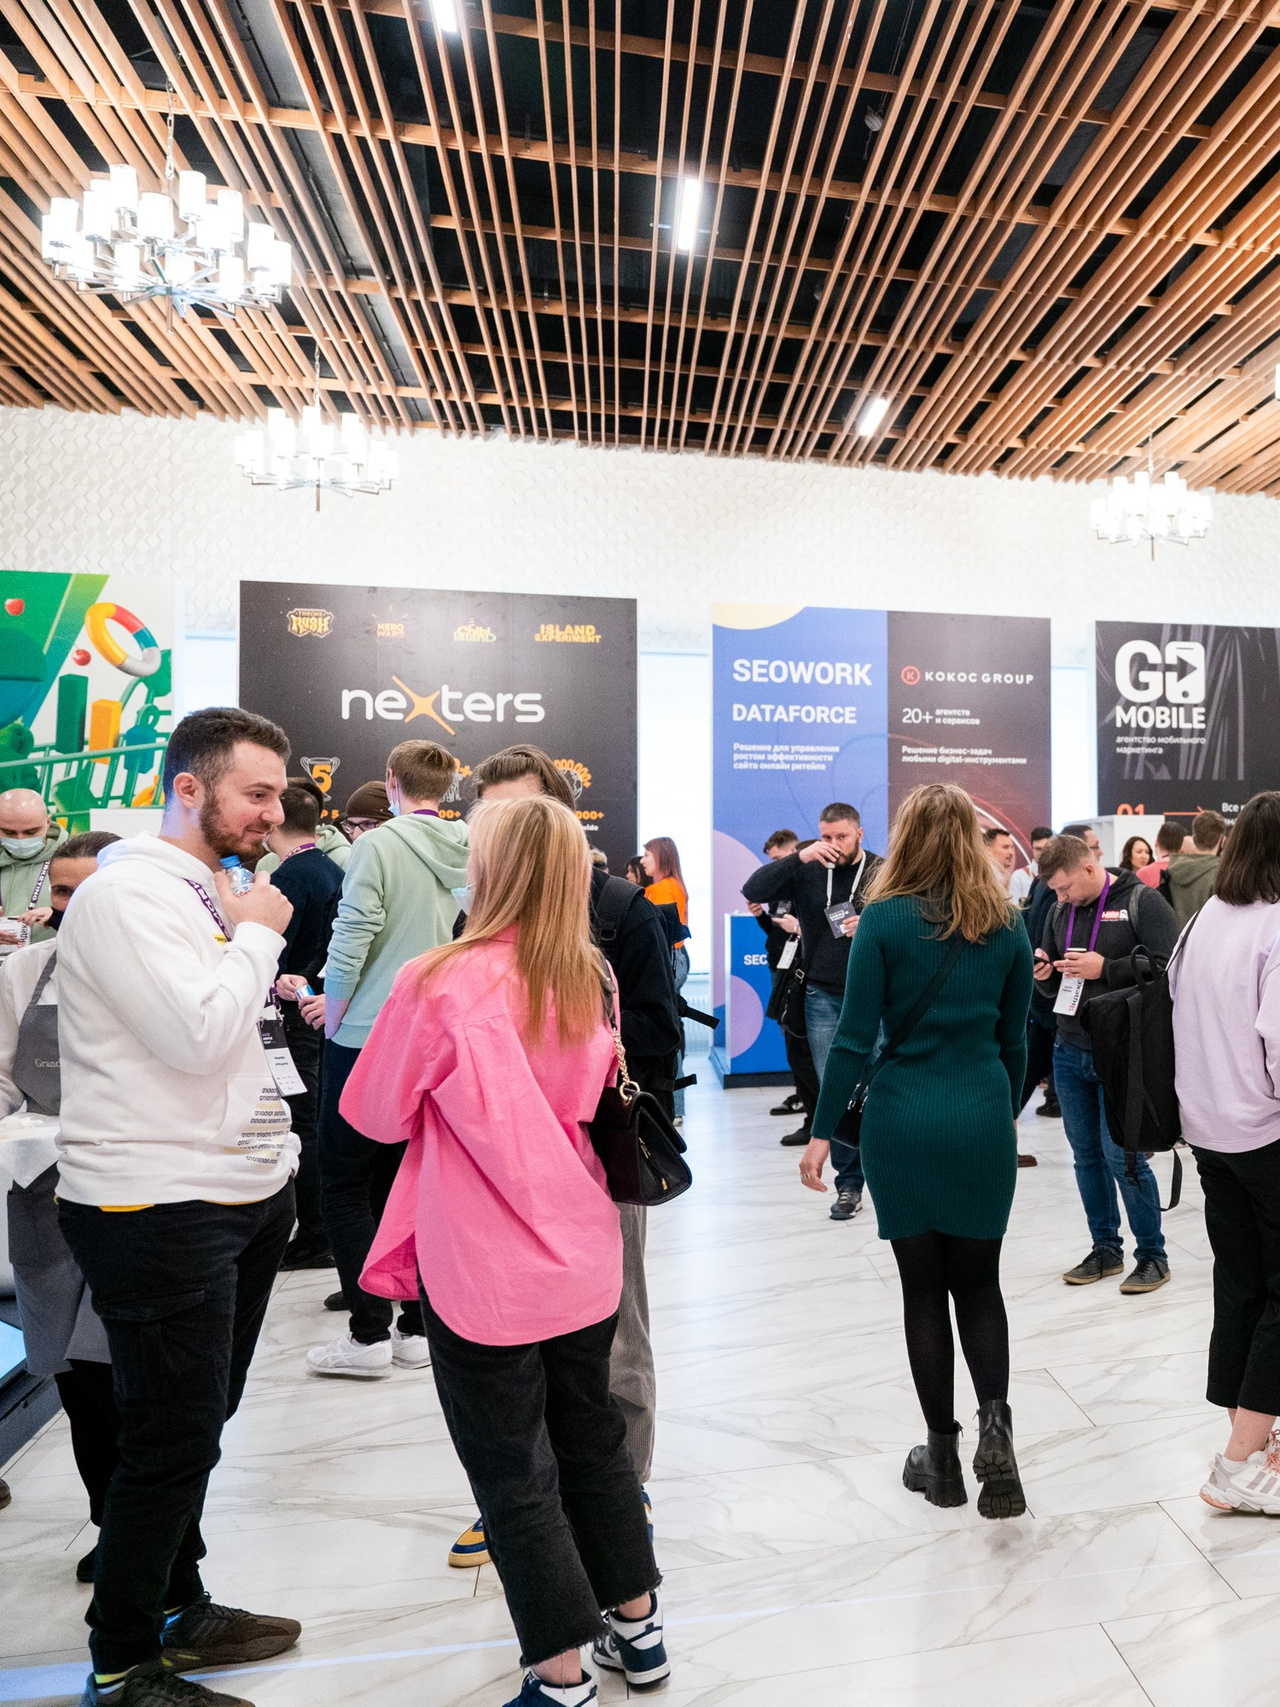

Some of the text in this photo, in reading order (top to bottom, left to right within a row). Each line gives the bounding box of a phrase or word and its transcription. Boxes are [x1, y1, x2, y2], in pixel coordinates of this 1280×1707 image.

[540, 624, 596, 635] ISLAND
[733, 659, 872, 686] SEOWORK
[925, 671, 978, 683] KOKOC
[981, 673, 1034, 684] GROUP
[341, 675, 546, 735] nexters
[733, 703, 857, 724] DATAFORCE
[902, 707, 933, 724] 20+
[1116, 705, 1206, 729] MOBILE
[1116, 735, 1206, 744] агентство мобильного
[1222, 802, 1239, 812] Все
